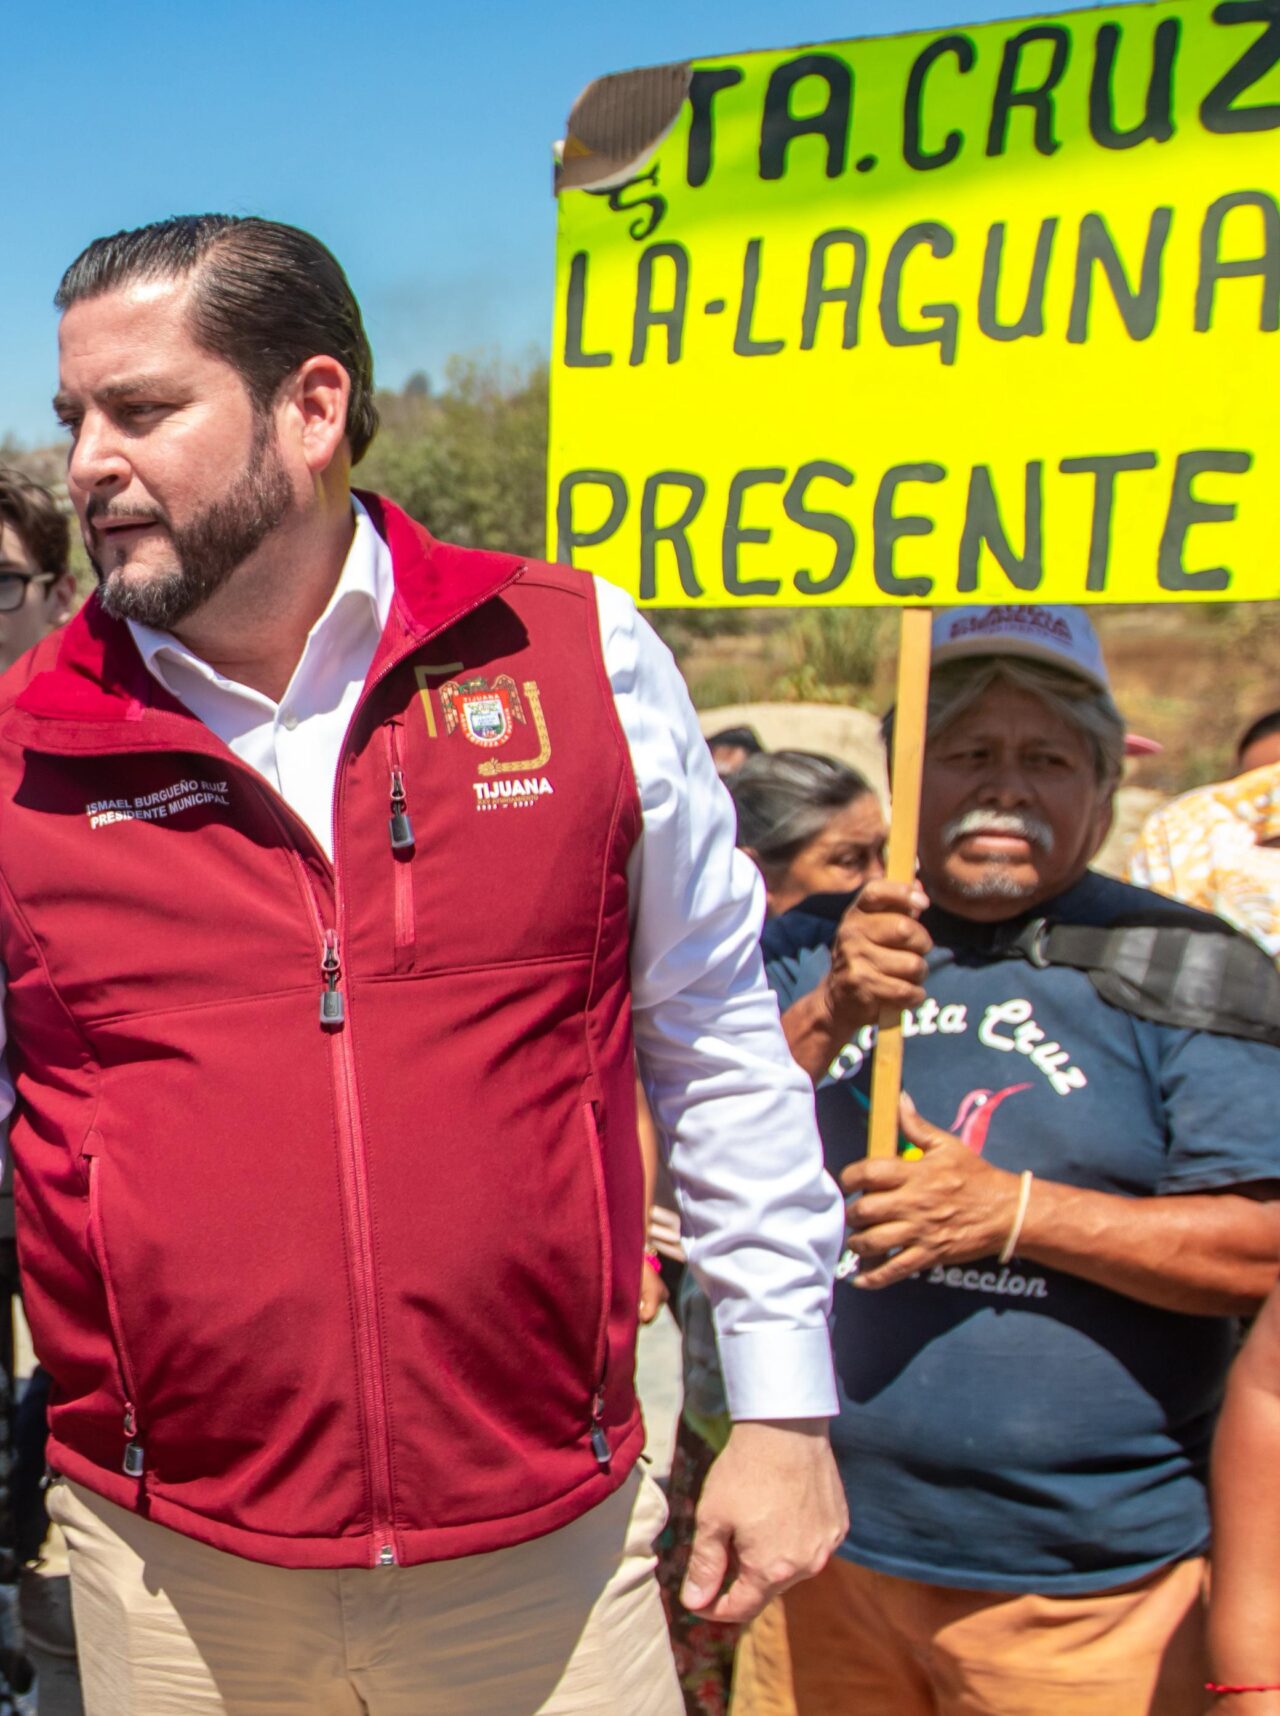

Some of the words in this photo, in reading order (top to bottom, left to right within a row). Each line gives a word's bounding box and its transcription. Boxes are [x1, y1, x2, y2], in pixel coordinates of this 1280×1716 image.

[557, 449, 1252, 600] PRESENTE
[86, 799, 132, 816] ISMAEL
[134, 779, 199, 808] BURGUEÑO
[200, 781, 228, 793] RUIZ
[473, 777, 554, 800] TIJUANA
[90, 805, 168, 830] PRESIDENTE
[169, 793, 230, 815] MUNICIPAL
[978, 998, 1088, 1097] Cruz
[927, 1264, 1049, 1299] seccion
